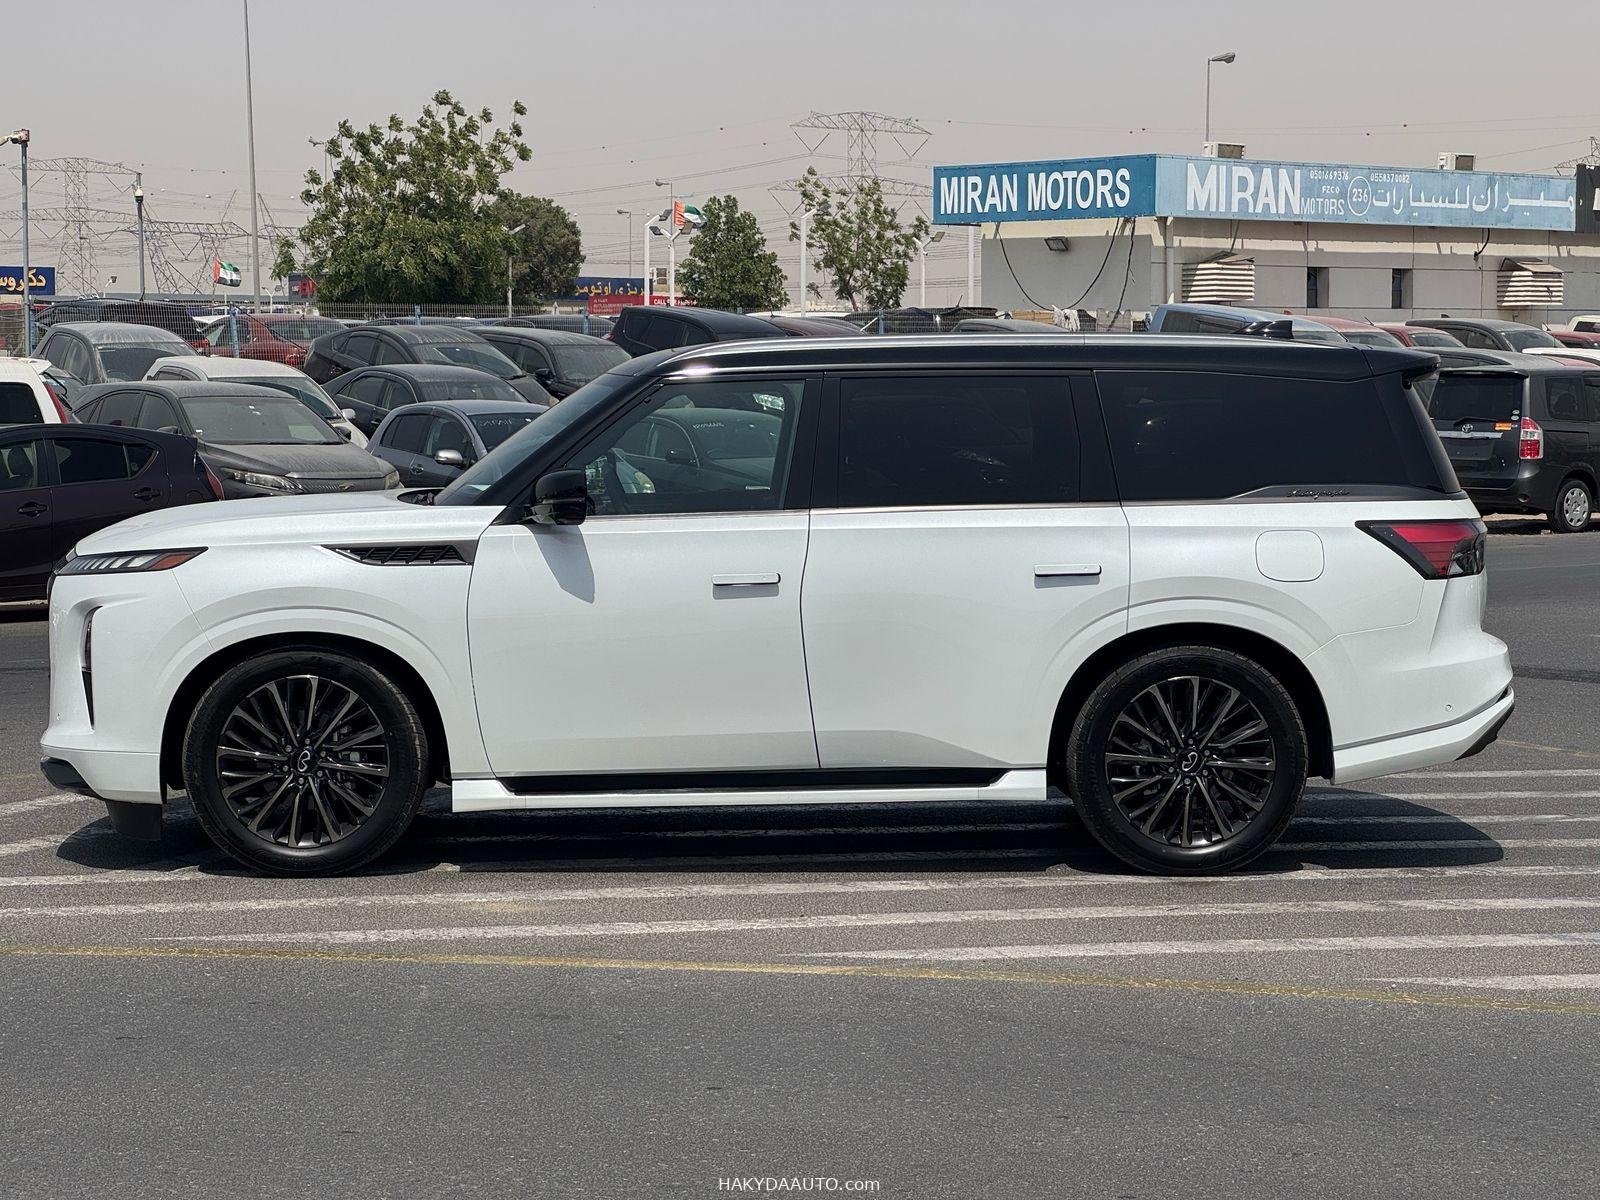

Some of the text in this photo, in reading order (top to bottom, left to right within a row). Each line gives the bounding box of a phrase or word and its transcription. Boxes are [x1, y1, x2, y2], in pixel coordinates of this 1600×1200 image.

[940, 168, 1131, 215] MIRAN MOTORS
[1186, 162, 1301, 215] MIRAN
[1351, 187, 1369, 204] 236
[1372, 183, 1471, 217] للسيارات
[1301, 196, 1346, 216] MOTORS
